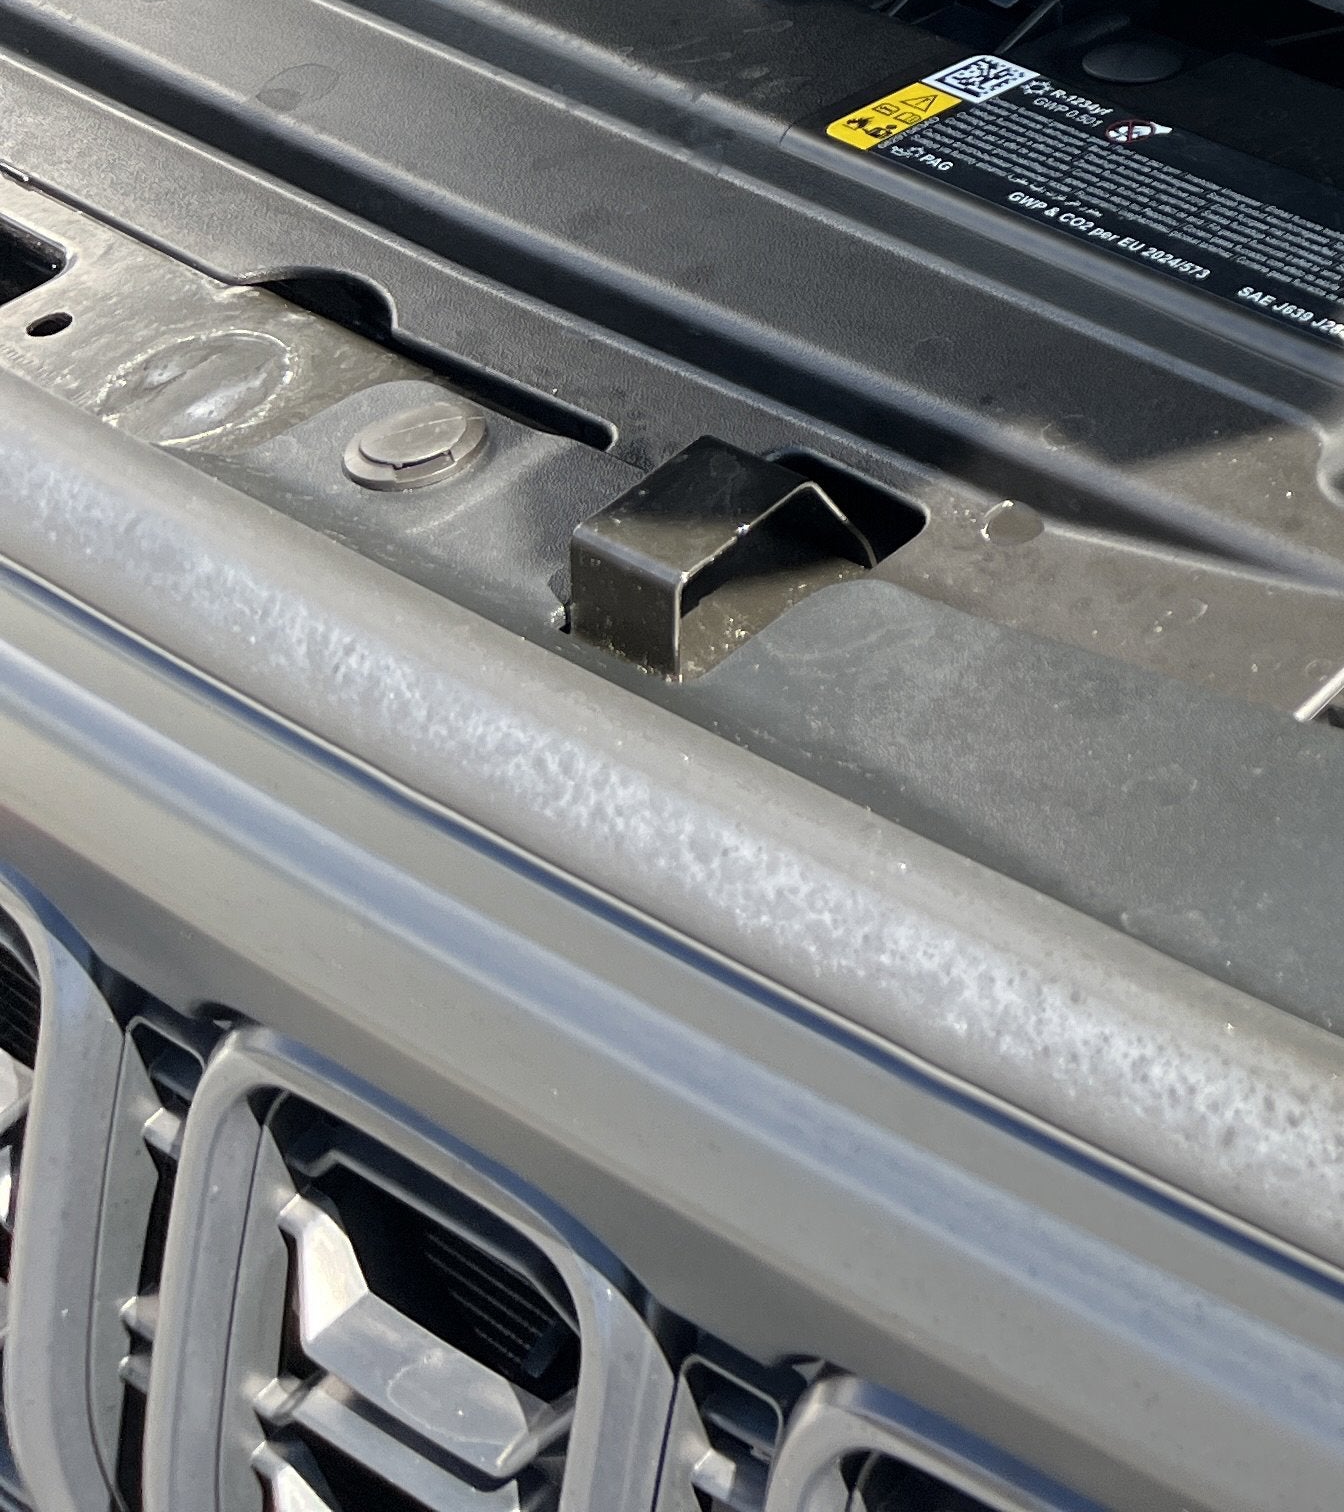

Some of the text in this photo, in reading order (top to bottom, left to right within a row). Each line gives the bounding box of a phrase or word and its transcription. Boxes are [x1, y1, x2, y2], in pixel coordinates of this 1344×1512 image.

[1033, 97, 1105, 129] GWP 0.501
[1051, 88, 1113, 117] R-1234yf
[920, 153, 954, 172] PAG
[1008, 191, 1211, 280] GWP & CO2 per EU 2024/573
[1237, 286, 1277, 307] SAE
[1271, 302, 1315, 322] J639
